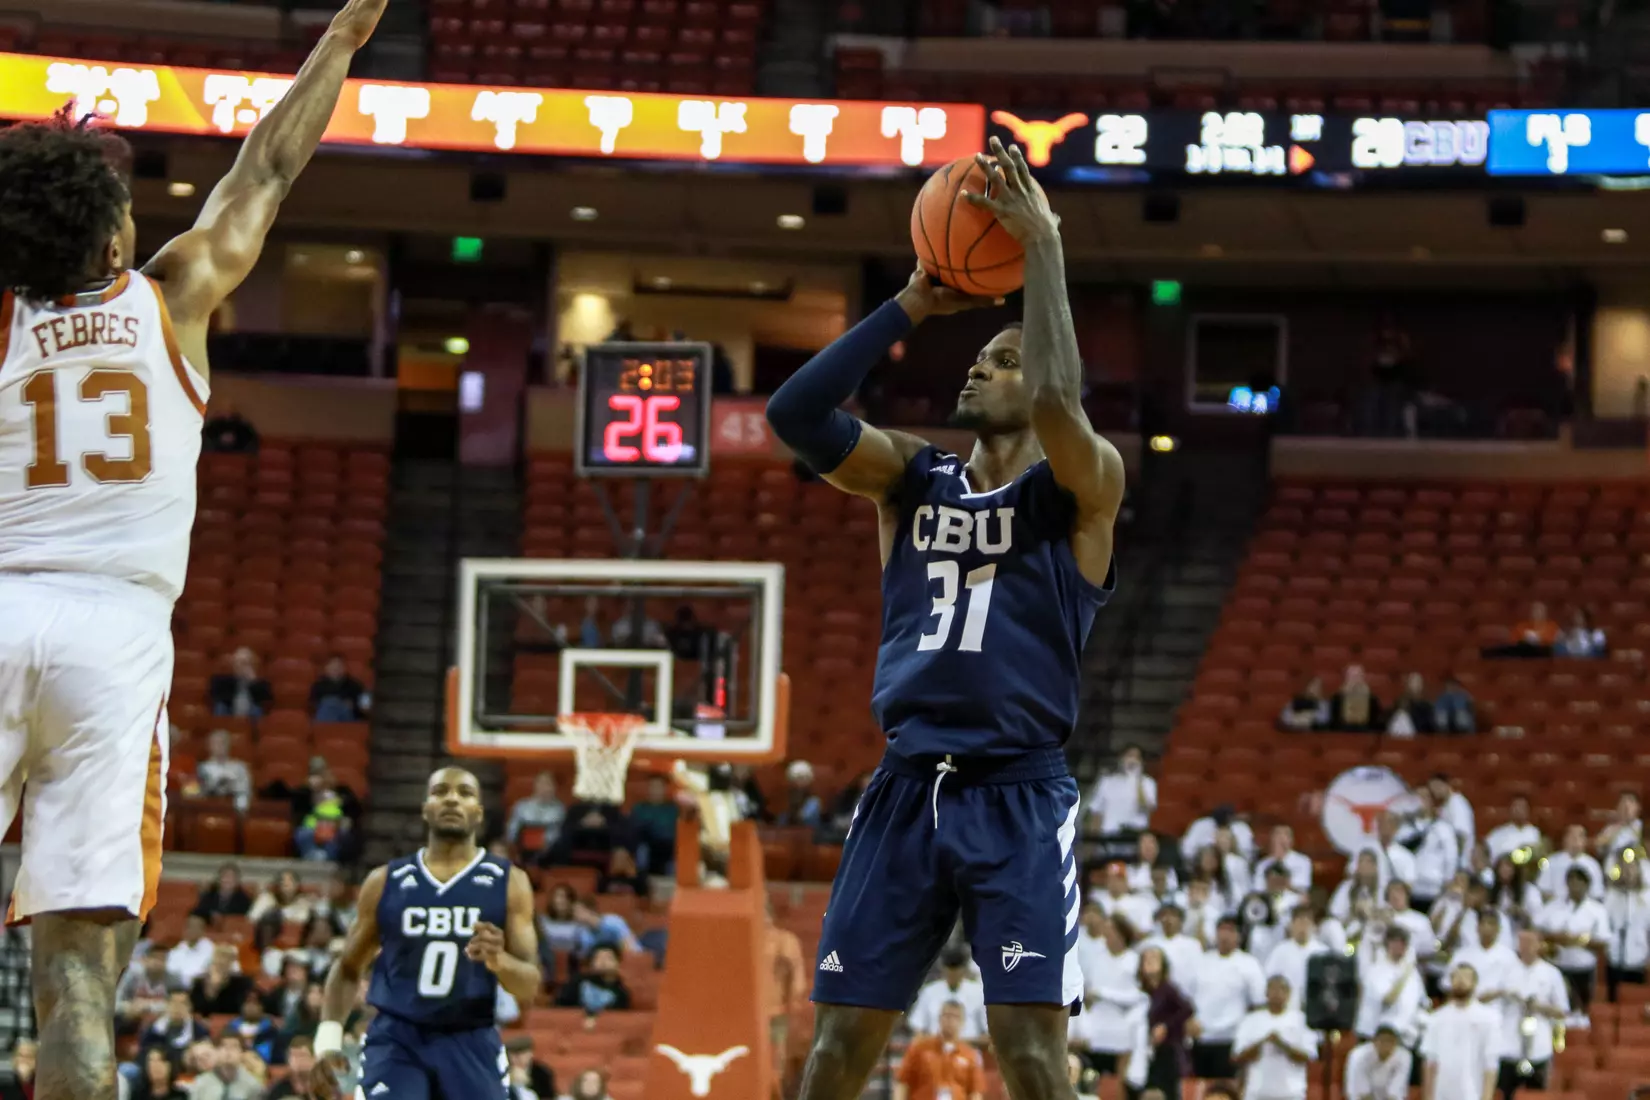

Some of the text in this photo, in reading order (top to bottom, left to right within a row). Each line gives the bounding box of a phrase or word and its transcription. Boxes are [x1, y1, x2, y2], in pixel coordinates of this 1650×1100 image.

[1095, 114, 1148, 164] 22
[1403, 121, 1489, 166] CBU
[31, 311, 140, 358] FEBRES
[620, 359, 695, 391] 2:03
[22, 367, 153, 490] 13
[603, 395, 683, 463] 26
[912, 504, 1015, 555] CBU
[916, 560, 998, 653] 31
[402, 906, 481, 937] CBU
[418, 941, 459, 997] 0
[820, 962, 843, 972] adidas
